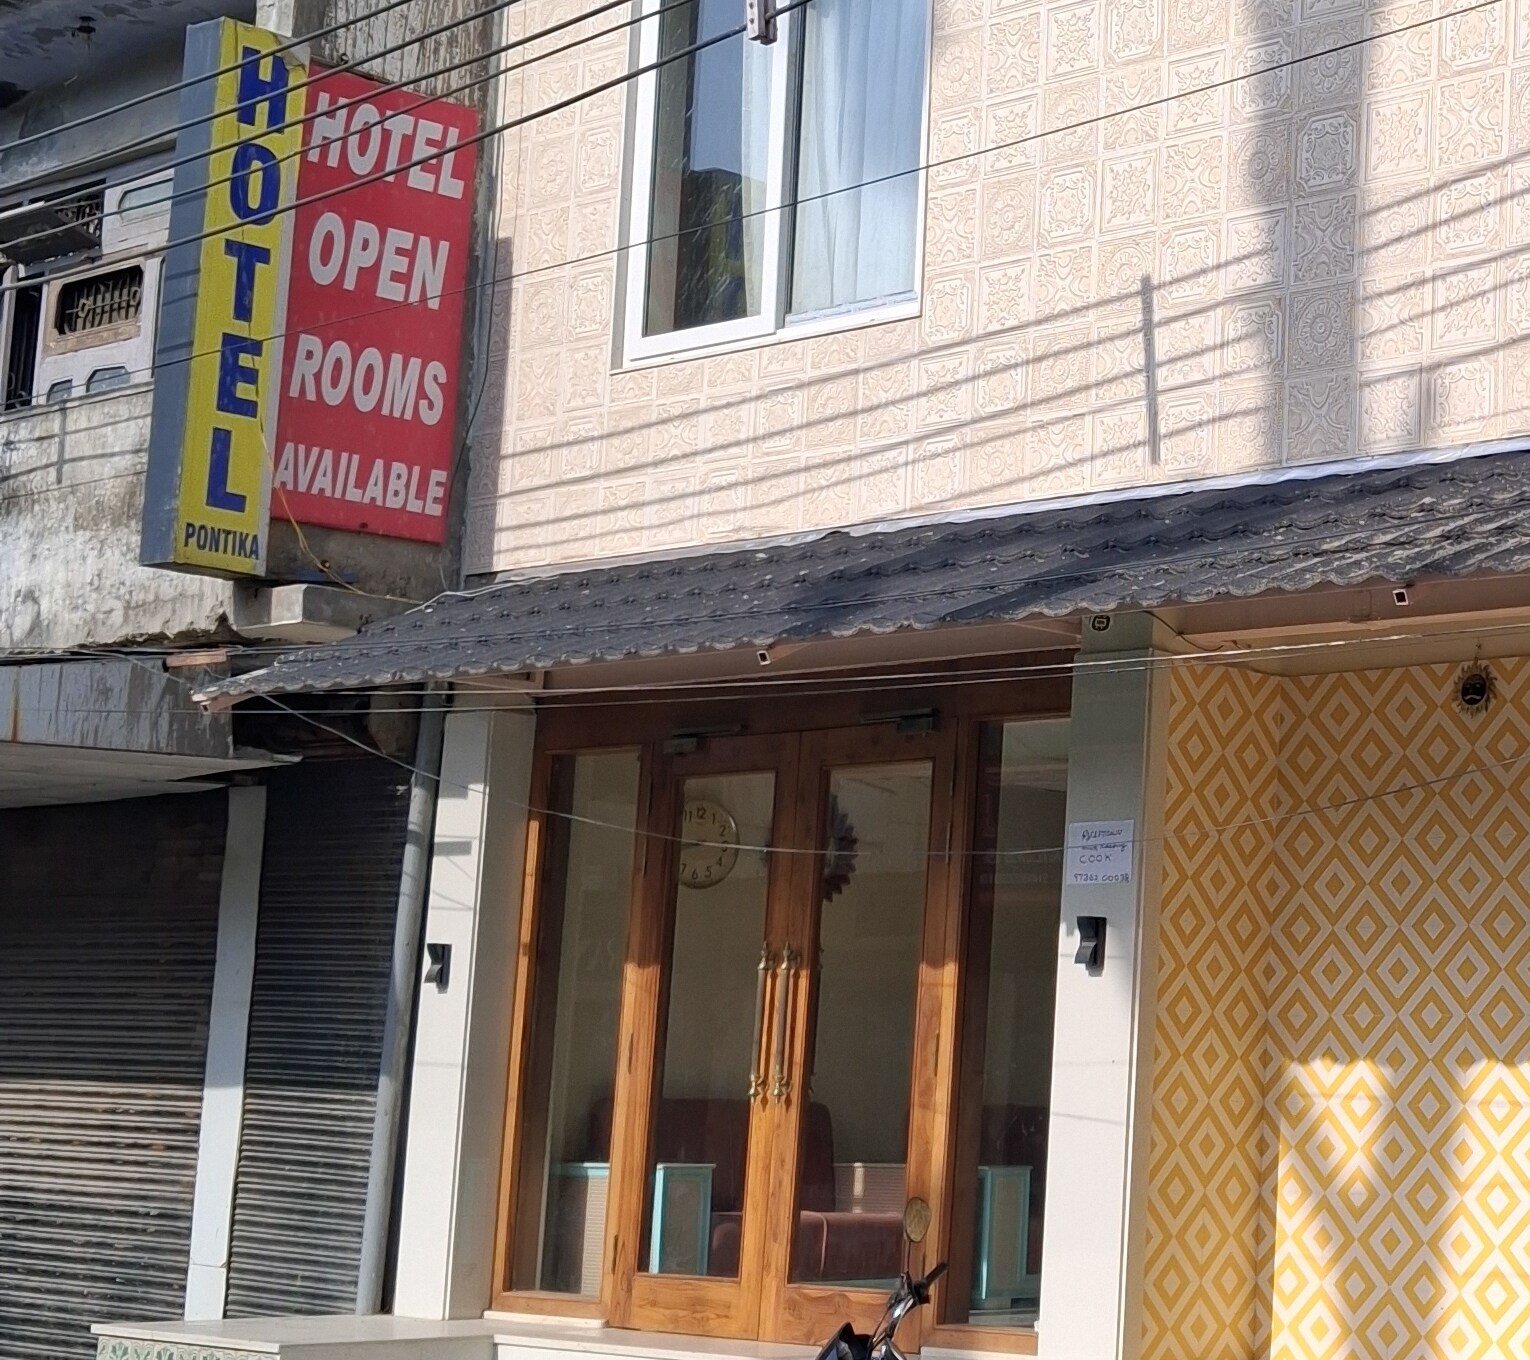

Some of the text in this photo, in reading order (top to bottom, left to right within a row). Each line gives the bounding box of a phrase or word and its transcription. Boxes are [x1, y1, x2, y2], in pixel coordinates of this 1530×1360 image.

[307, 91, 465, 200] HOTEL
[205, 45, 290, 513] HOTEL
[308, 211, 449, 310] OPEN
[288, 333, 448, 426] ROOMS
[273, 442, 448, 518] AVAILABLE
[183, 522, 260, 561] PONTIKA
